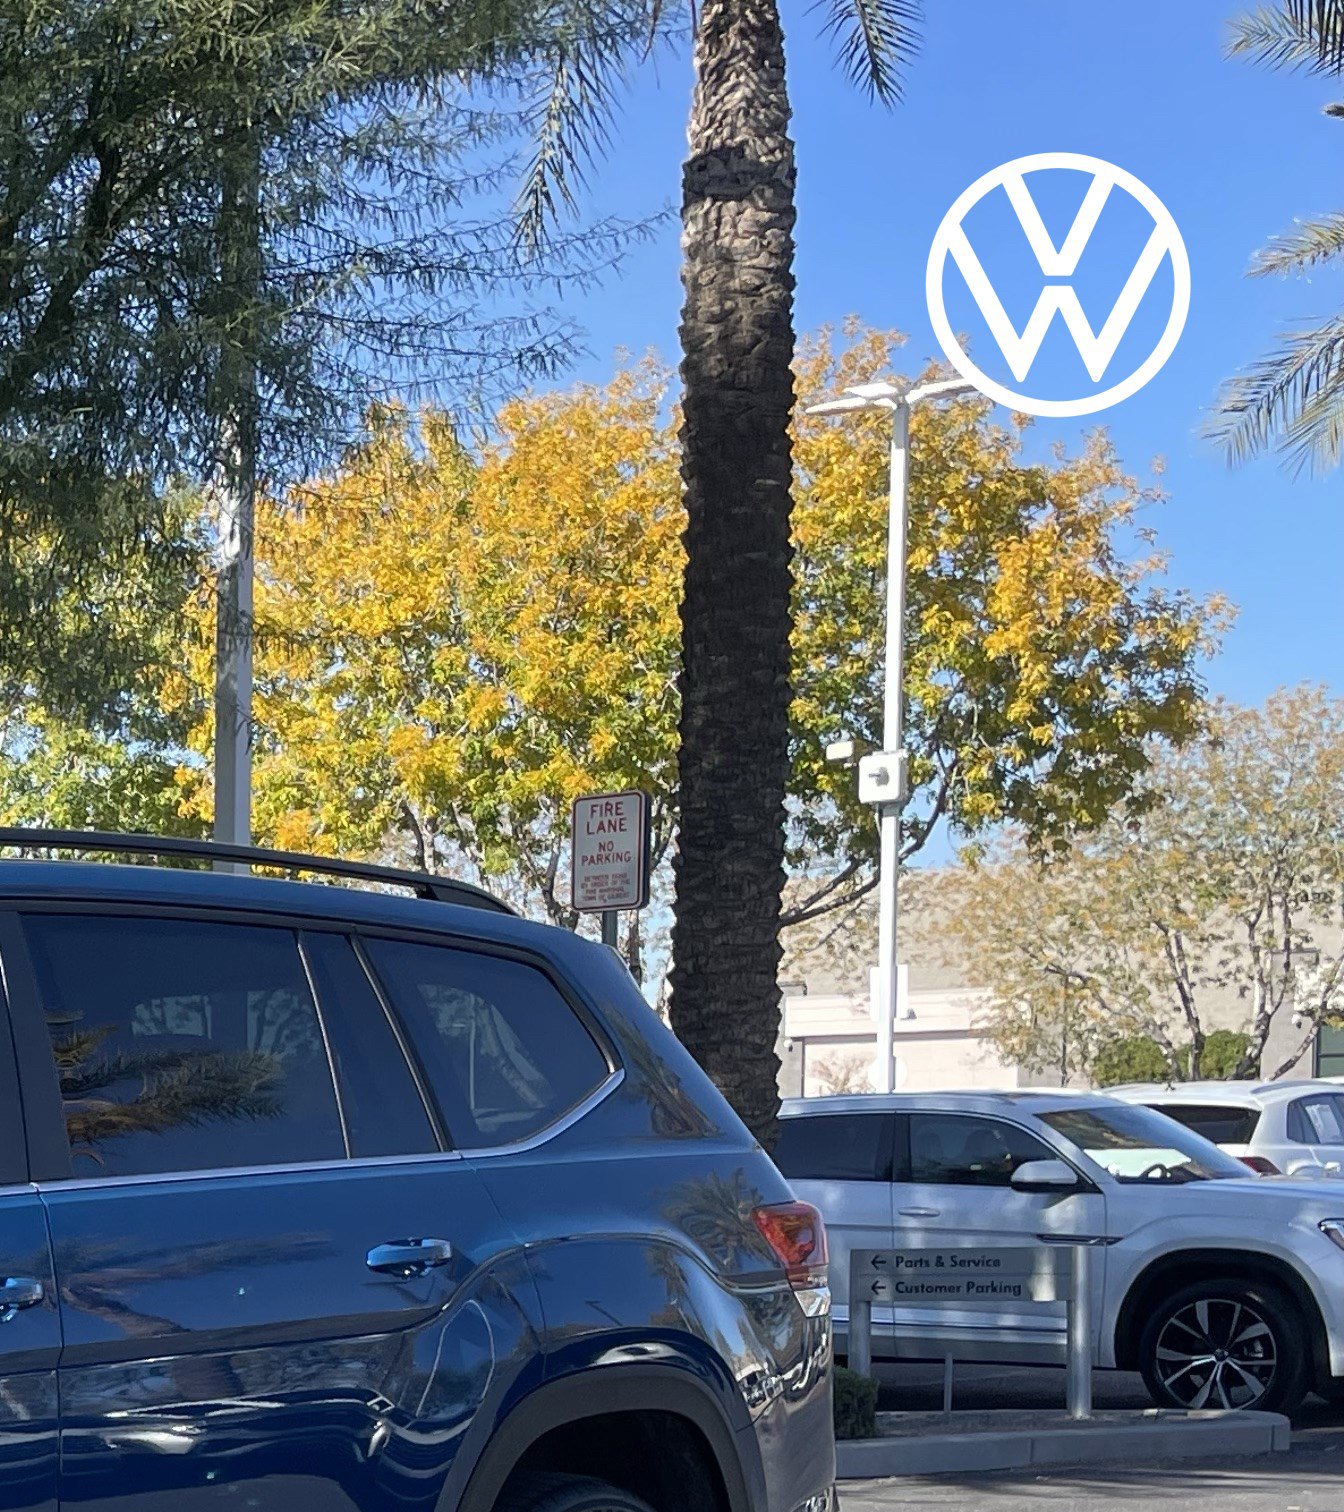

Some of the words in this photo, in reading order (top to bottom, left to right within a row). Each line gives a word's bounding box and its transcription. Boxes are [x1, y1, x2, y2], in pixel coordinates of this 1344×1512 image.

[590, 801, 624, 819] FIRE
[586, 817, 627, 835] LANE
[598, 841, 615, 853] NO
[581, 851, 632, 867] PARKING
[895, 1255, 930, 1268] Parts
[934, 1255, 944, 1268] &
[950, 1255, 1001, 1268] Service
[895, 1281, 961, 1294] Customer
[966, 1280, 1022, 1297] Parking
